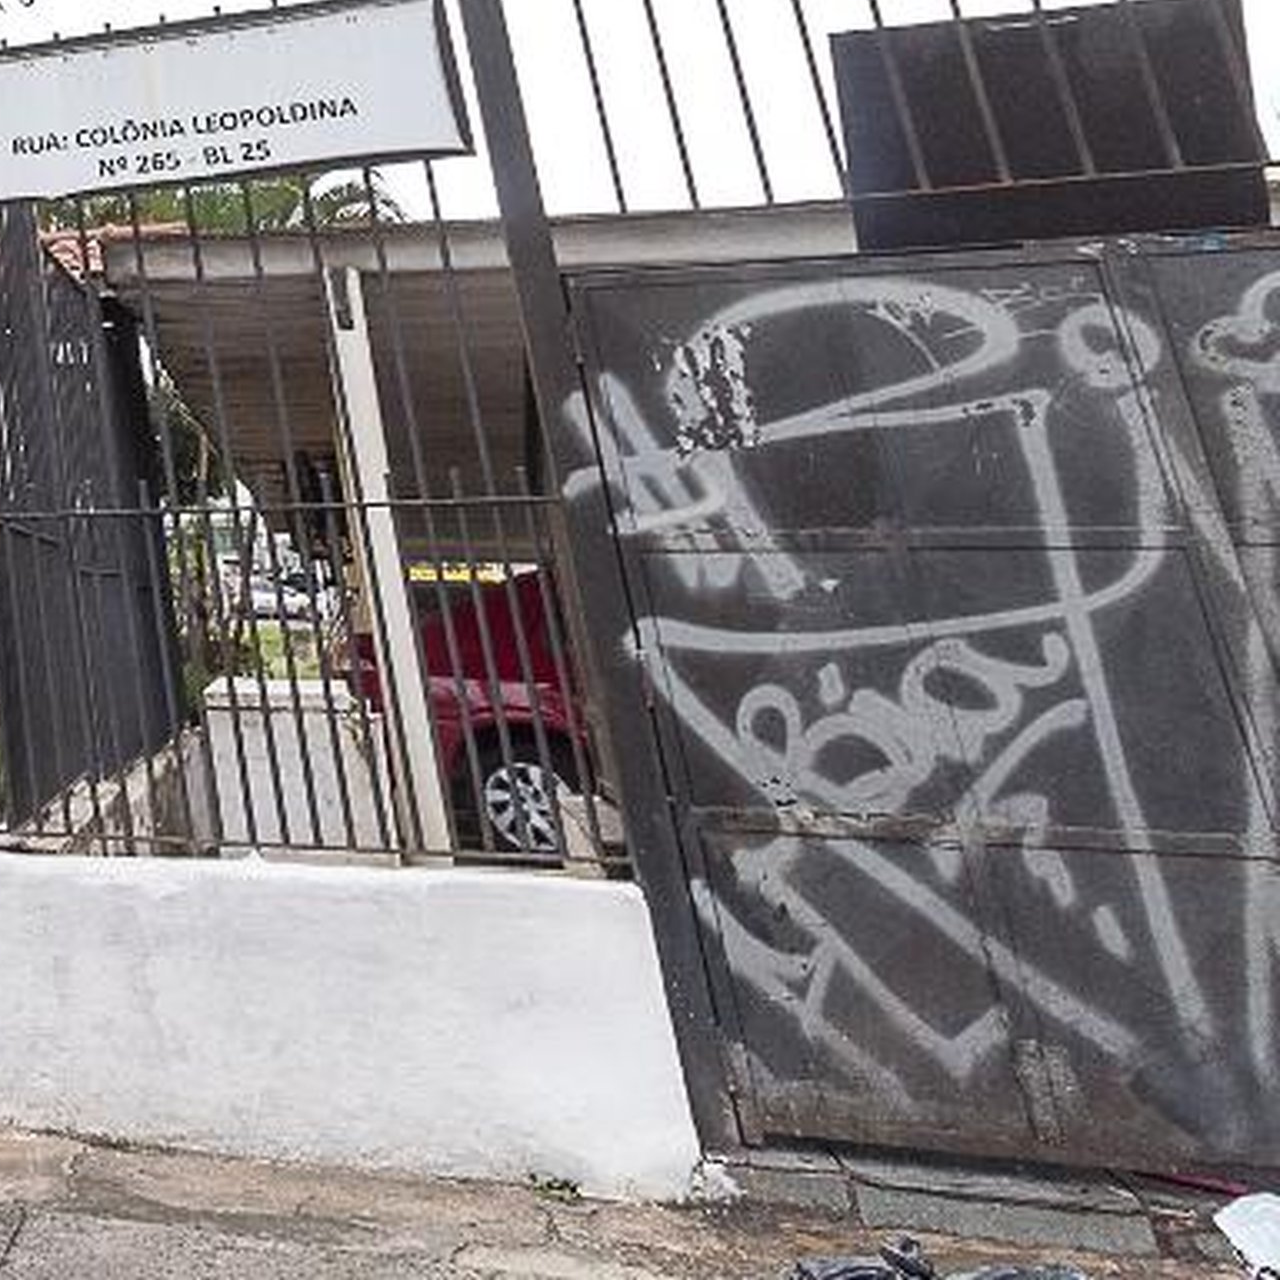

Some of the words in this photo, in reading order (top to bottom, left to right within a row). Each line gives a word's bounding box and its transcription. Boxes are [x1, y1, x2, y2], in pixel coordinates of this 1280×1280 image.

[12, 132, 69, 154] RUA:
[75, 119, 185, 147] COLÔNIA
[191, 97, 358, 134] LEOPOLDINA
[135, 152, 182, 173] 265
[202, 146, 233, 165] BL
[240, 139, 271, 161] 25
